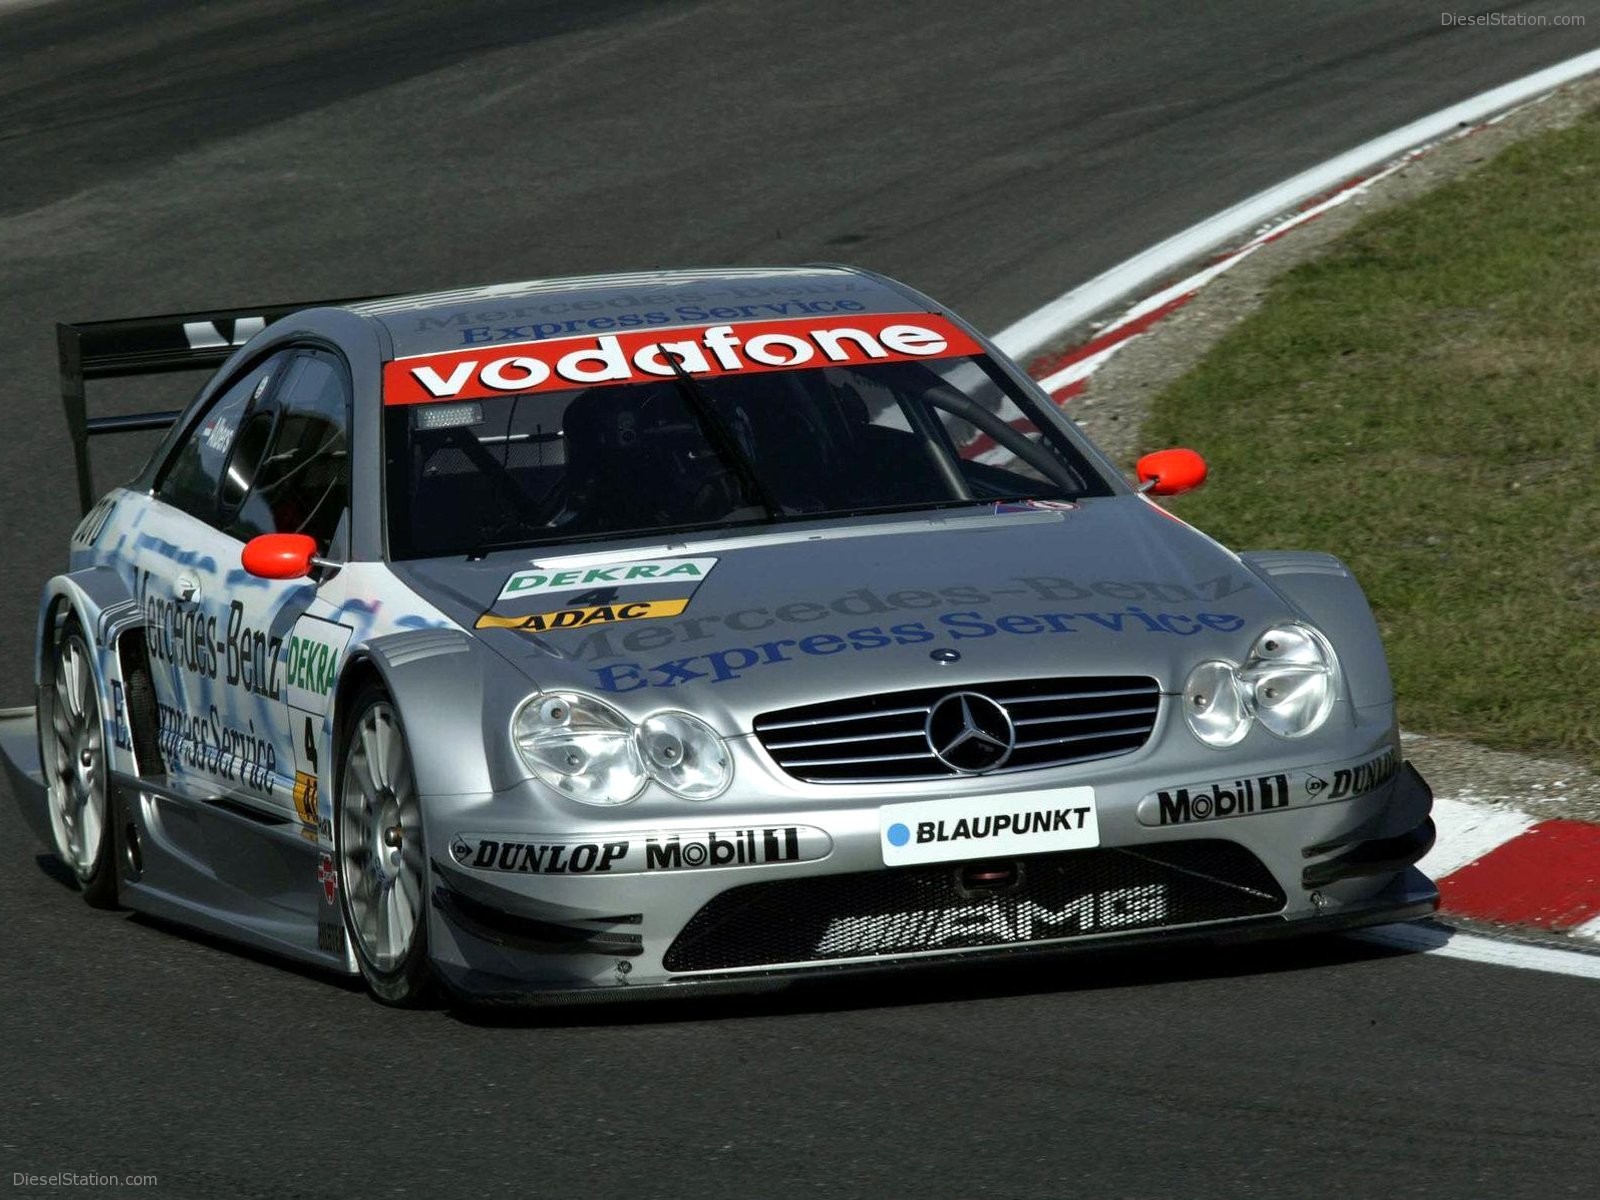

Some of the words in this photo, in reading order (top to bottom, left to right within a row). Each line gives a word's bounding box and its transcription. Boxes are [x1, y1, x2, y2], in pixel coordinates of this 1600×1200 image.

[458, 310, 671, 346] Express
[674, 298, 866, 322] Service
[410, 324, 948, 398] vodafone
[506, 561, 702, 593] DEKRA
[514, 603, 652, 632] ADAC
[524, 574, 1252, 662] Mercedes-Benz
[287, 635, 338, 696] DEKRA
[589, 620, 935, 694] Express
[938, 606, 1245, 641] Service
[1157, 779, 1255, 825] Mobil
[1259, 773, 1290, 810] 1
[473, 840, 630, 873] DUNLOP
[646, 830, 756, 869] Mobil
[763, 827, 800, 862] 1
[916, 806, 1091, 844] BLAUPUNKT
